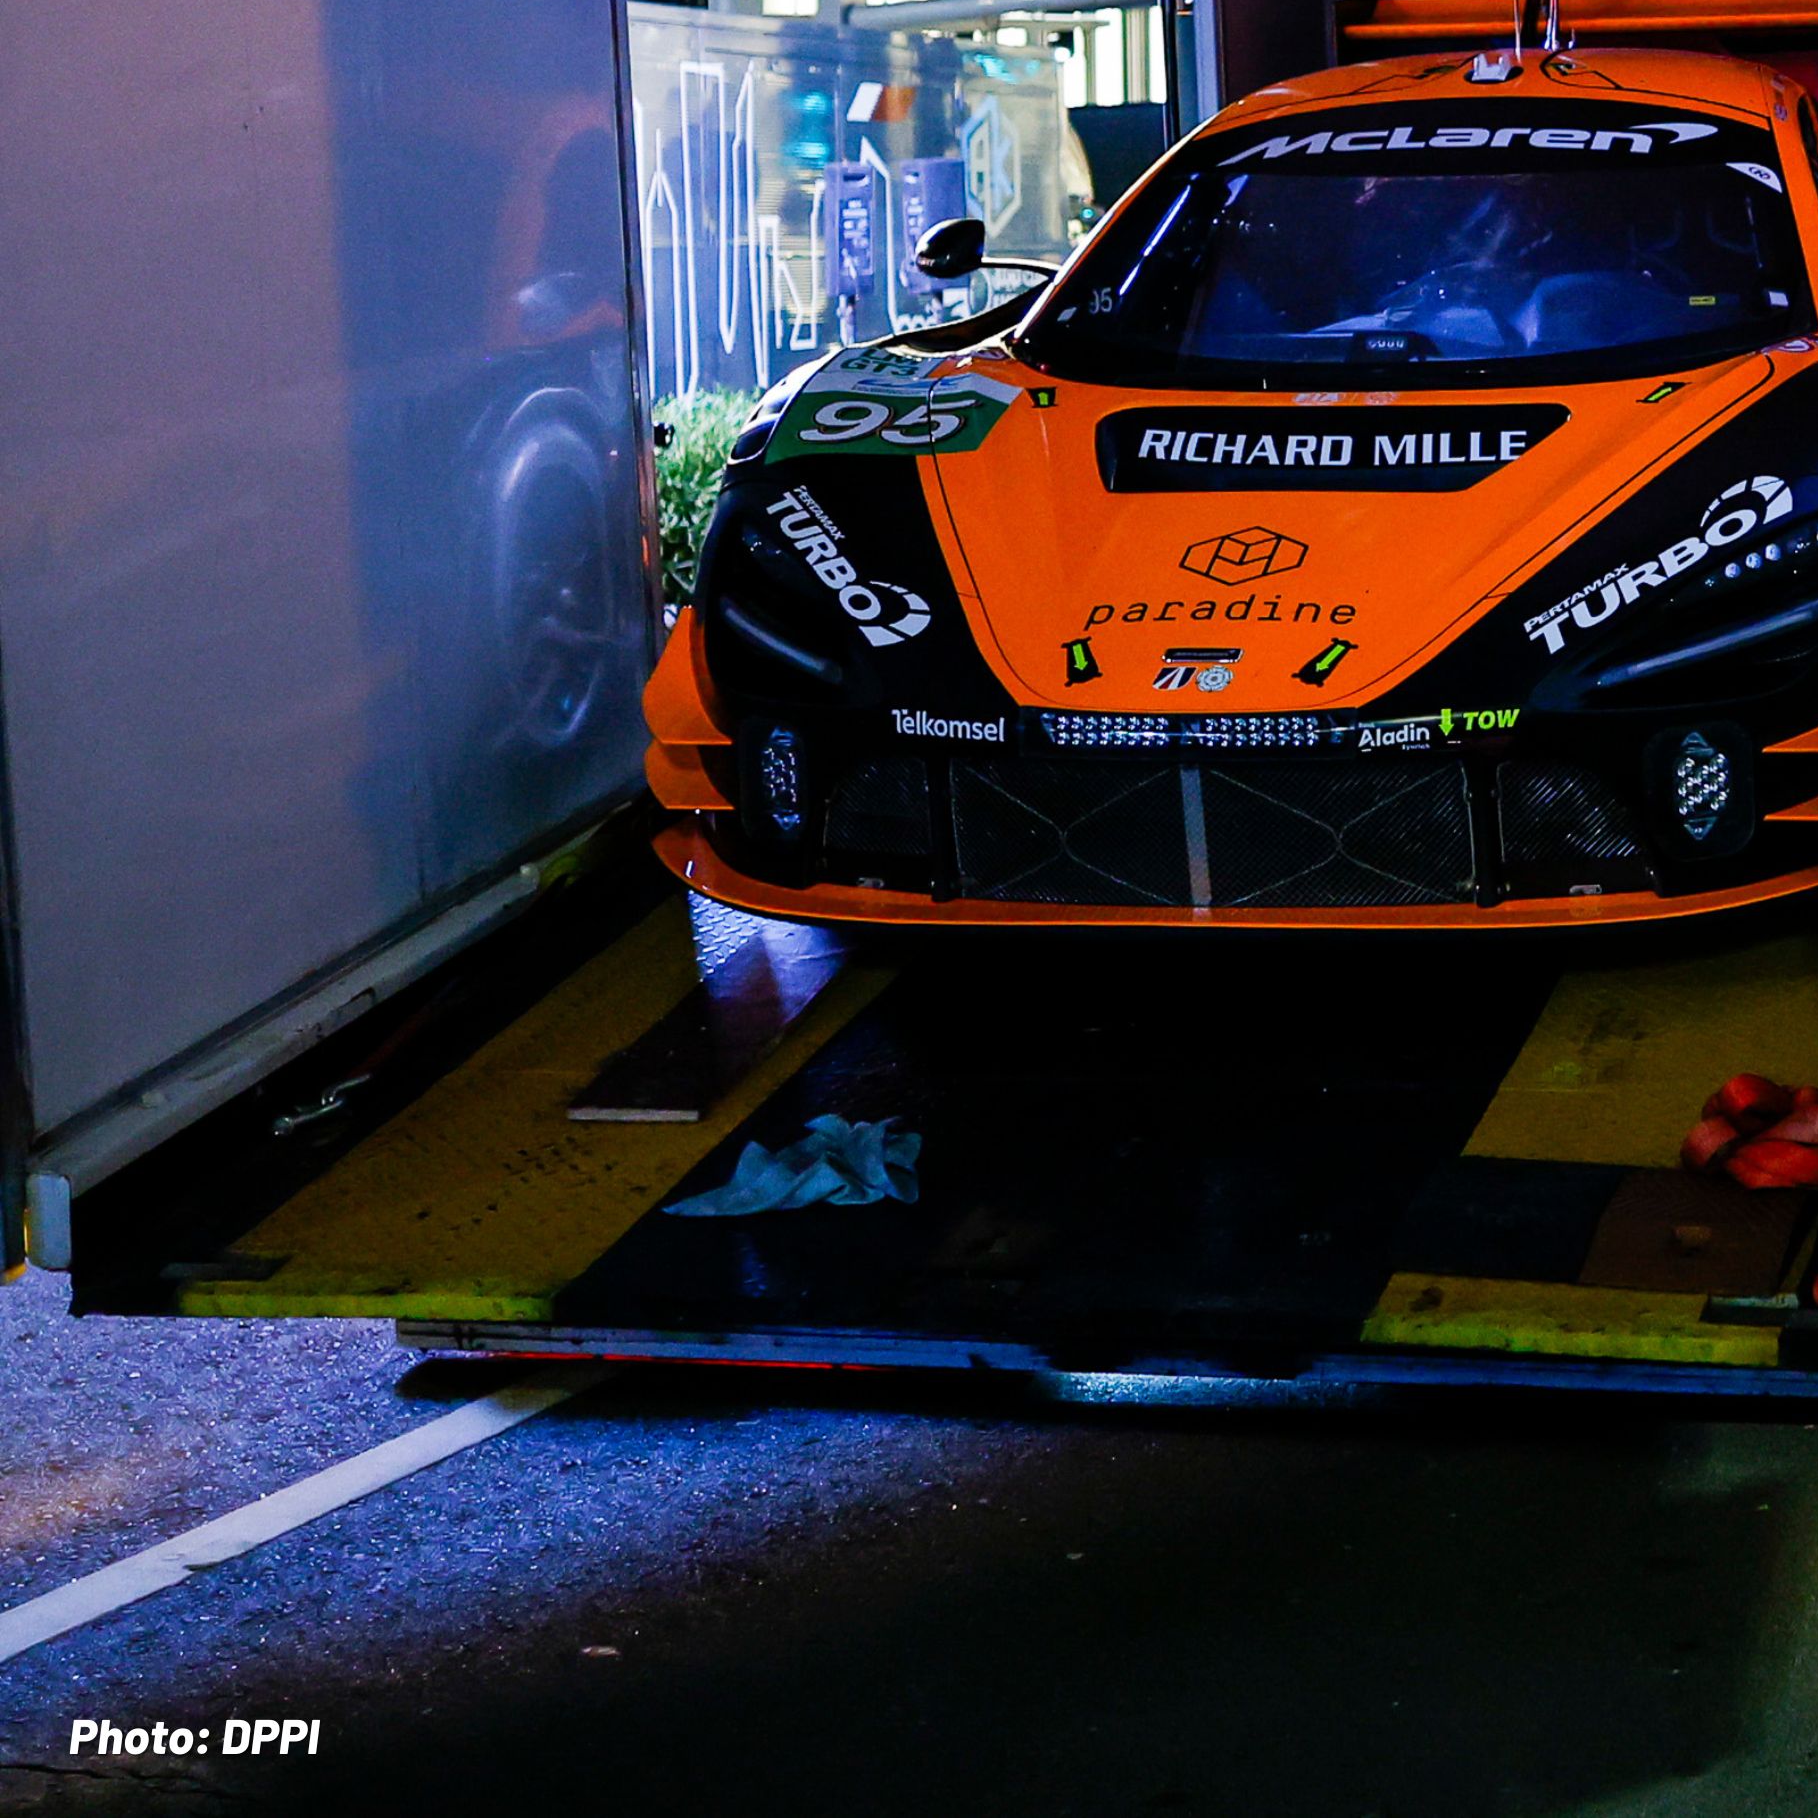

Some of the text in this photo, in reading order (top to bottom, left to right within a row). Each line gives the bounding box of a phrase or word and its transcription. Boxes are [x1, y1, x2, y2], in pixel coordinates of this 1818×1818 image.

[840, 357, 919, 376] GT3
[799, 400, 981, 444] 95
[1138, 429, 1527, 466] RICHARD MILLE
[793, 485, 846, 540] PERTAMAX
[766, 491, 882, 620] TURBO
[1523, 563, 1629, 633] PERTAMAX
[1529, 509, 1757, 654] TURBO
[1084, 595, 1358, 631] paradine
[891, 709, 1005, 742] Telkomsel
[1358, 723, 1430, 748] Aladin
[1463, 708, 1520, 730] TOW
